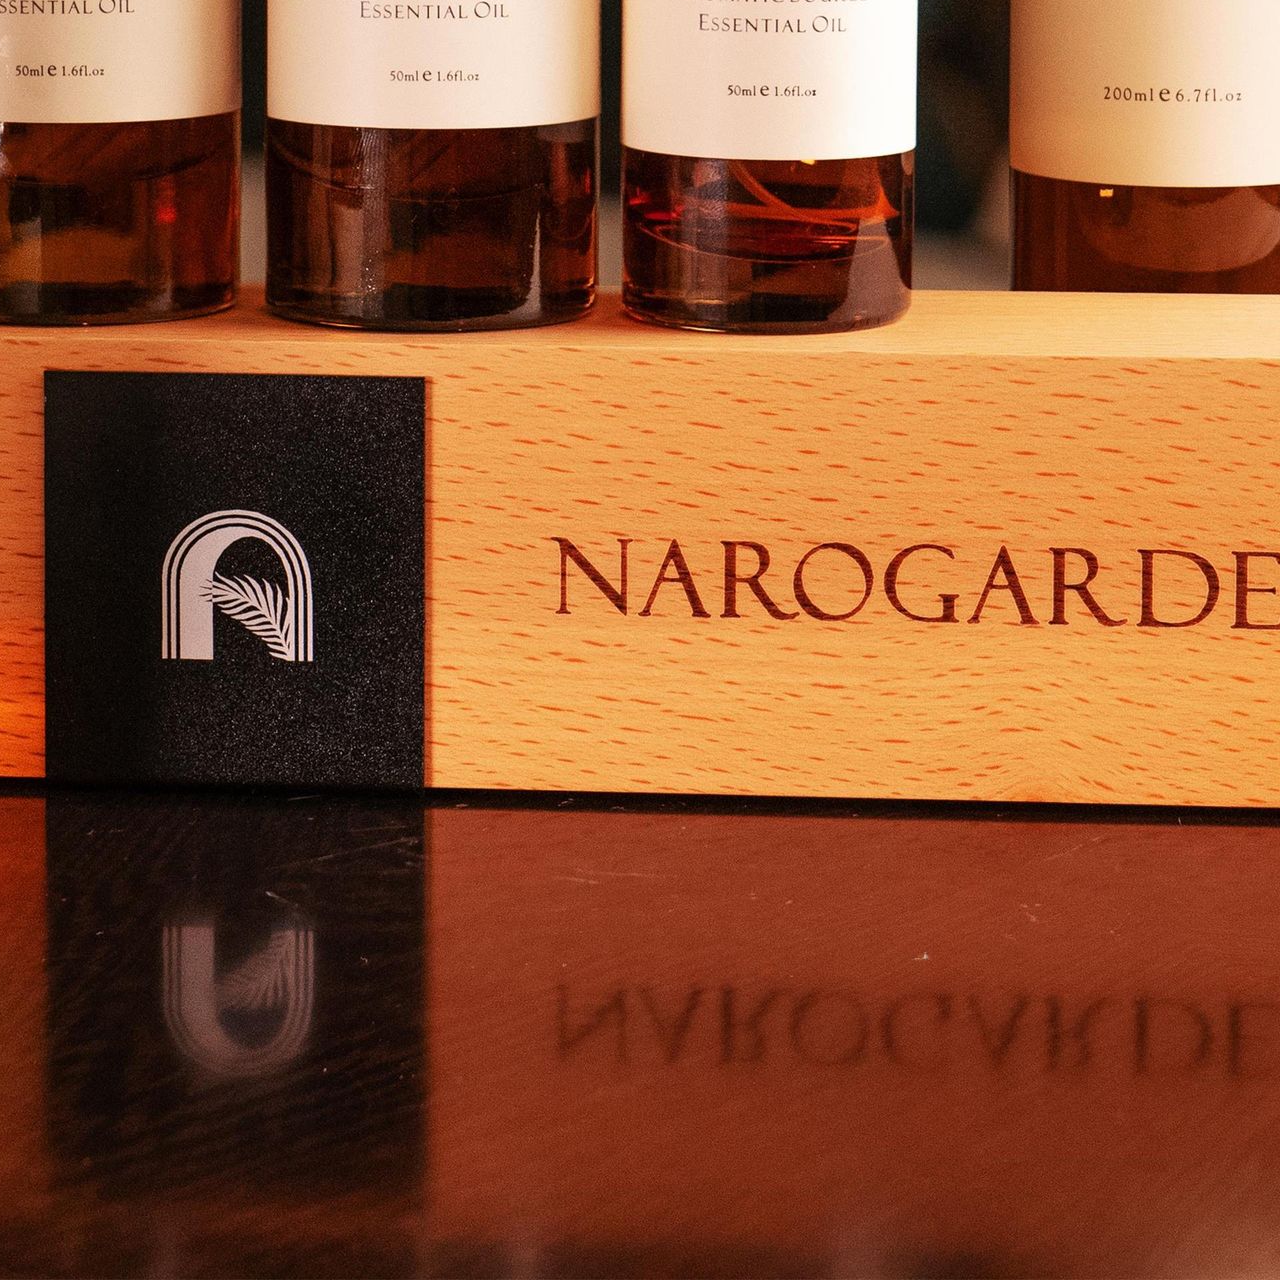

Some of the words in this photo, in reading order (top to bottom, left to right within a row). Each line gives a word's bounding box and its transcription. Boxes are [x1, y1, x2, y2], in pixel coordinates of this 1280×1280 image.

[15, 64, 45, 77] 50ml
[389, 69, 419, 82] 50ml
[727, 84, 757, 97] 50ml
[1103, 86, 1154, 102] 200ml
